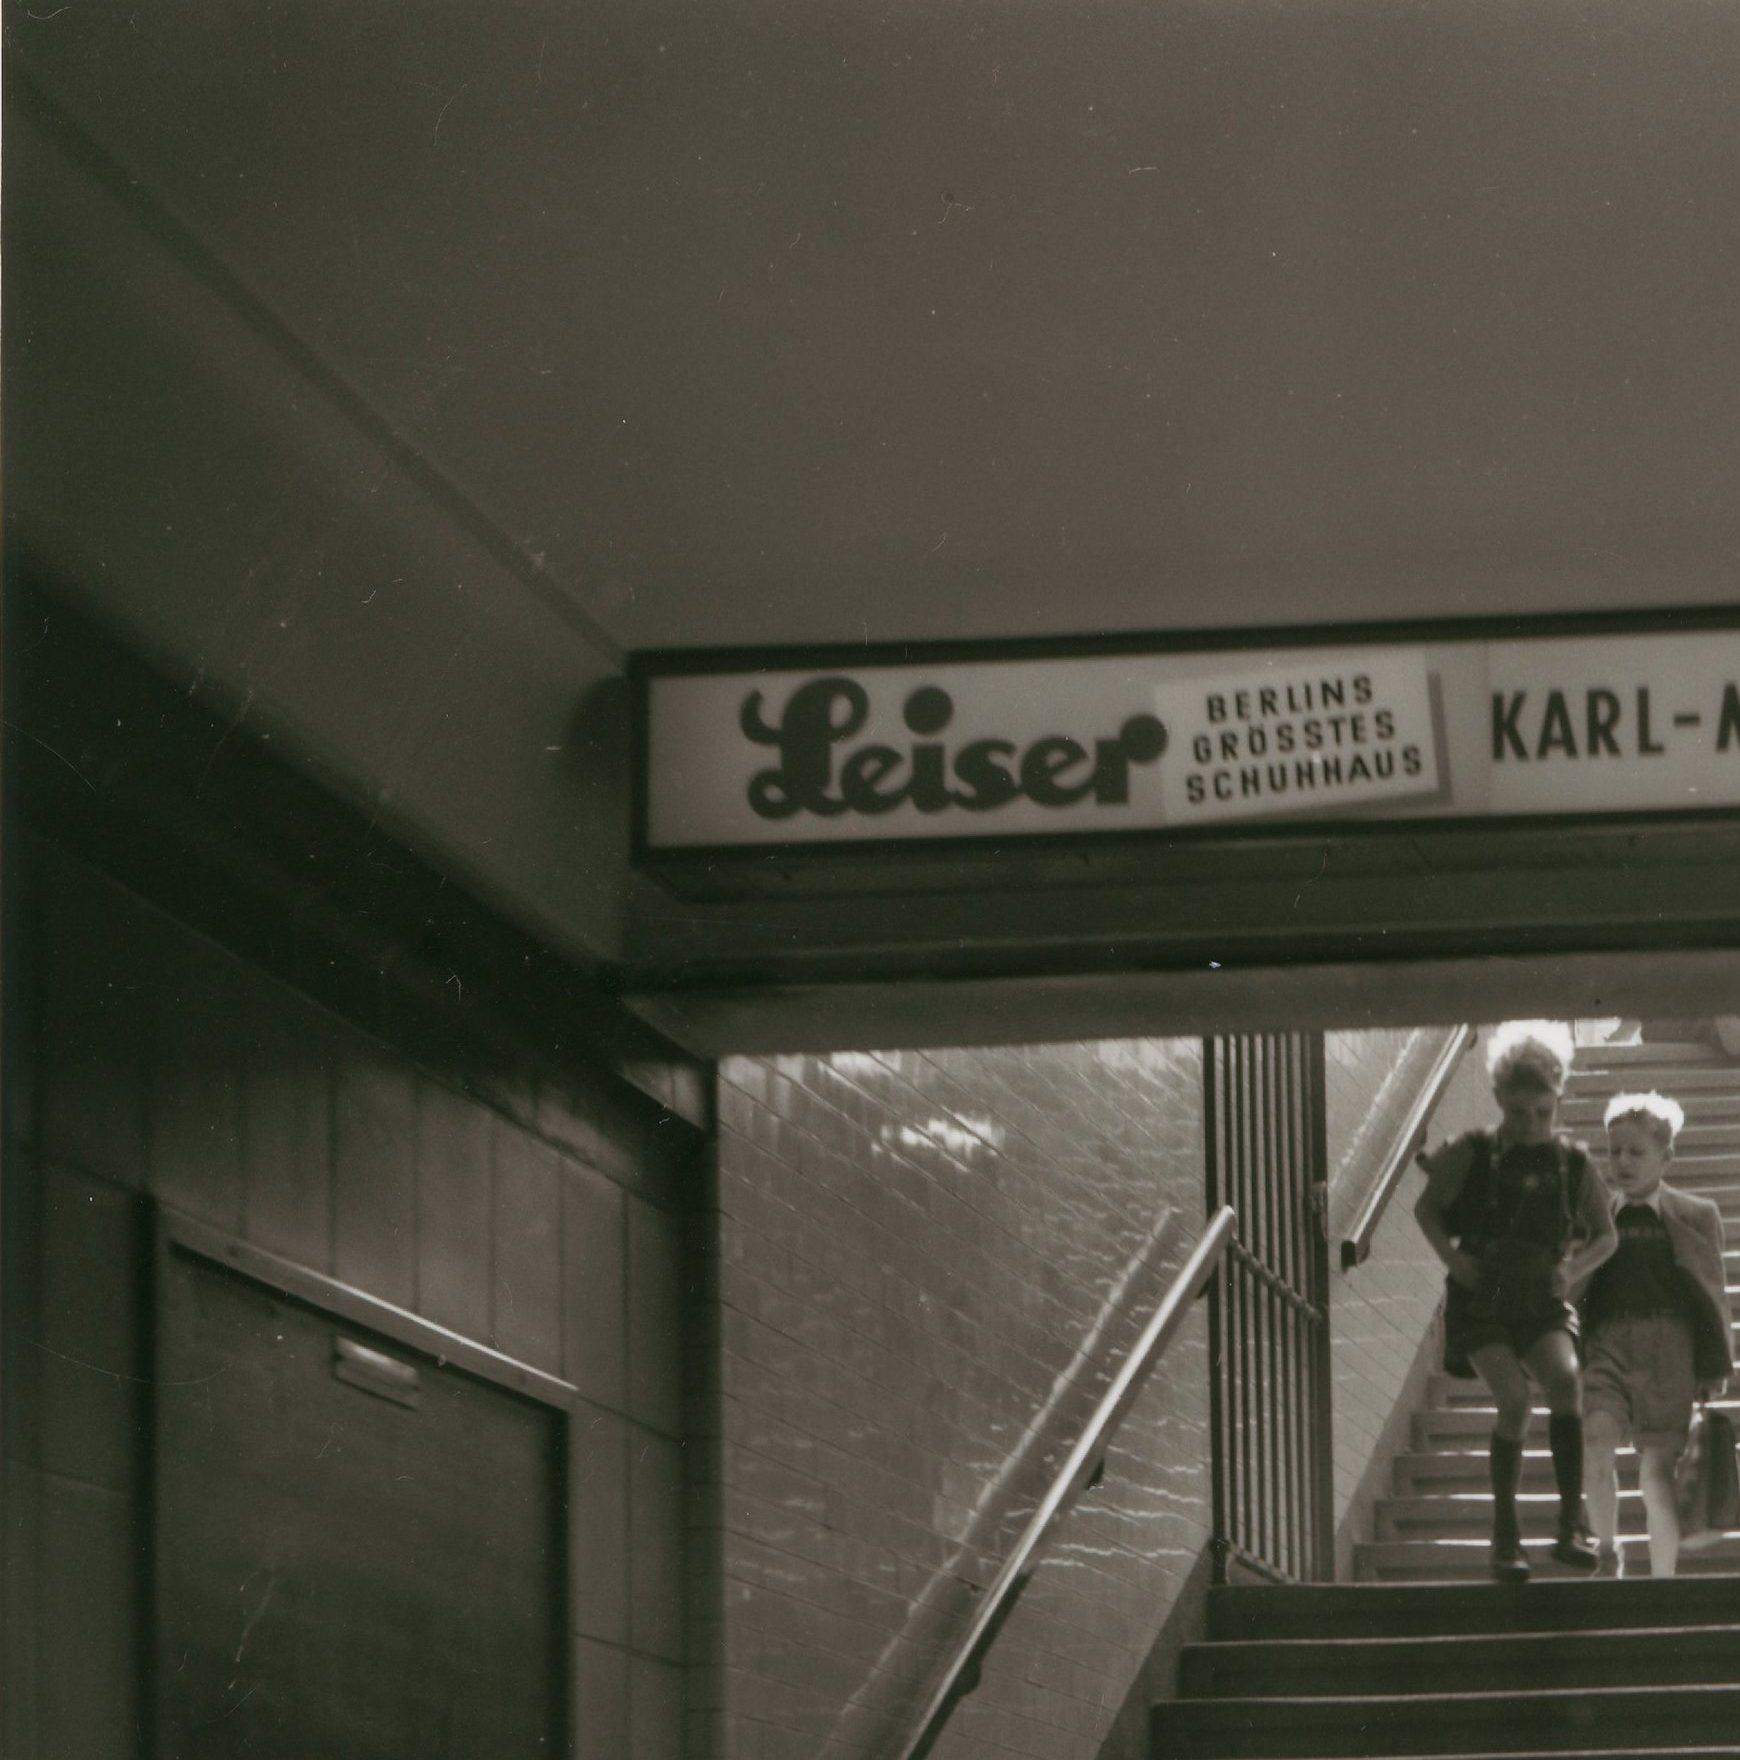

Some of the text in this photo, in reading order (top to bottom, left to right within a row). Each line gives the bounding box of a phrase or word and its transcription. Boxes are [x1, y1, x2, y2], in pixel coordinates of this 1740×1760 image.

[1206, 673, 1373, 724] BERLINS
[740, 676, 1168, 820] Leiser
[1192, 710, 1396, 765] GRÖSSTES
[1186, 746, 1424, 803] SCHUHHAUS
